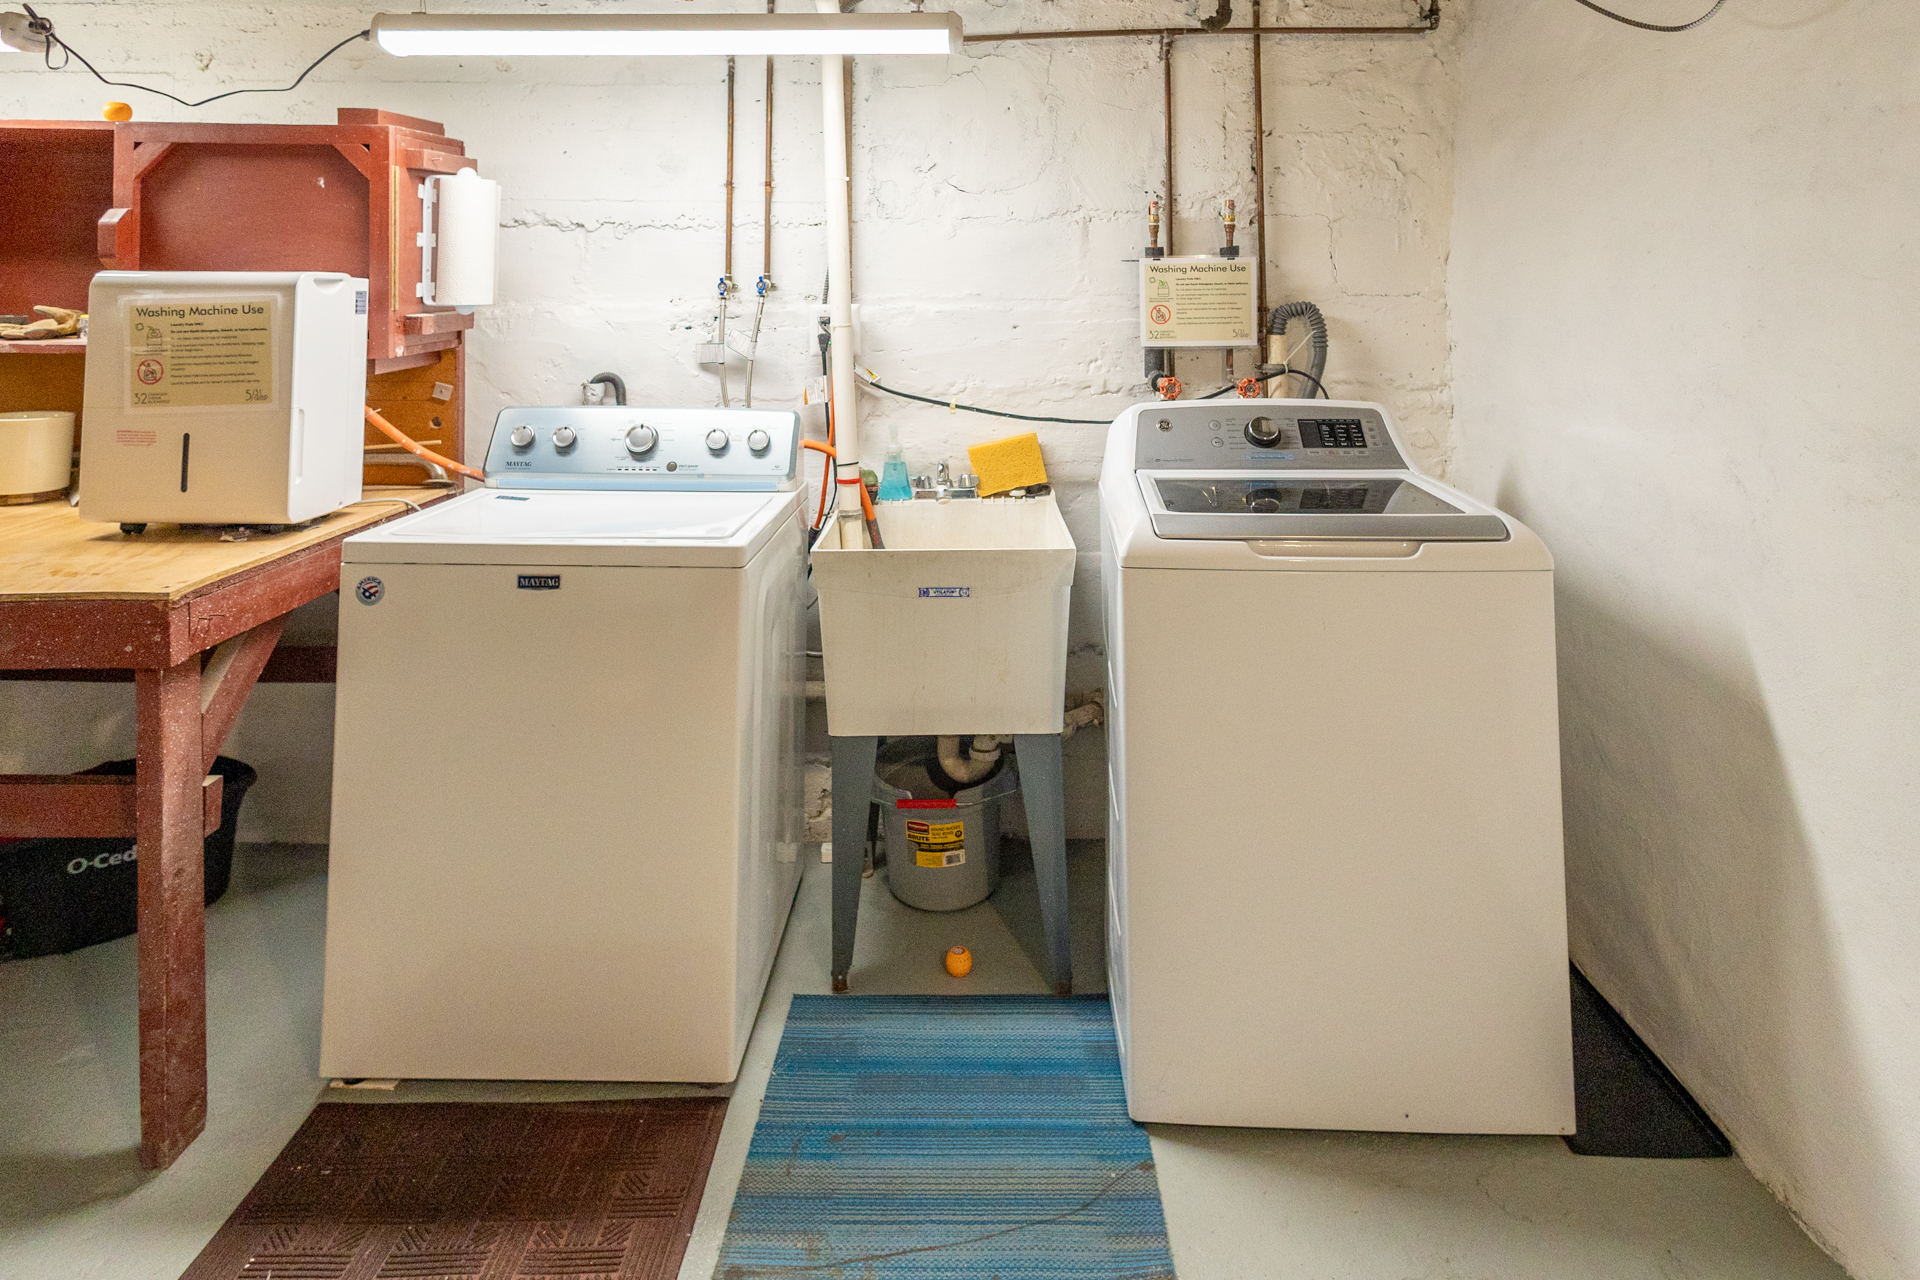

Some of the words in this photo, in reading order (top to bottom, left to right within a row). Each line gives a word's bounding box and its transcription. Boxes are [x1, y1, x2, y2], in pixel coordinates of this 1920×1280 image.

[1150, 265, 1187, 274] Washing
[1190, 264, 1227, 273] Machine
[1230, 264, 1246, 272] Use
[136, 307, 185, 318] Washing
[189, 305, 238, 316] Machine
[242, 305, 264, 314] Use
[134, 392, 147, 404] 32
[357, 577, 381, 590] AMERICA
[519, 578, 559, 587] MAYTAG
